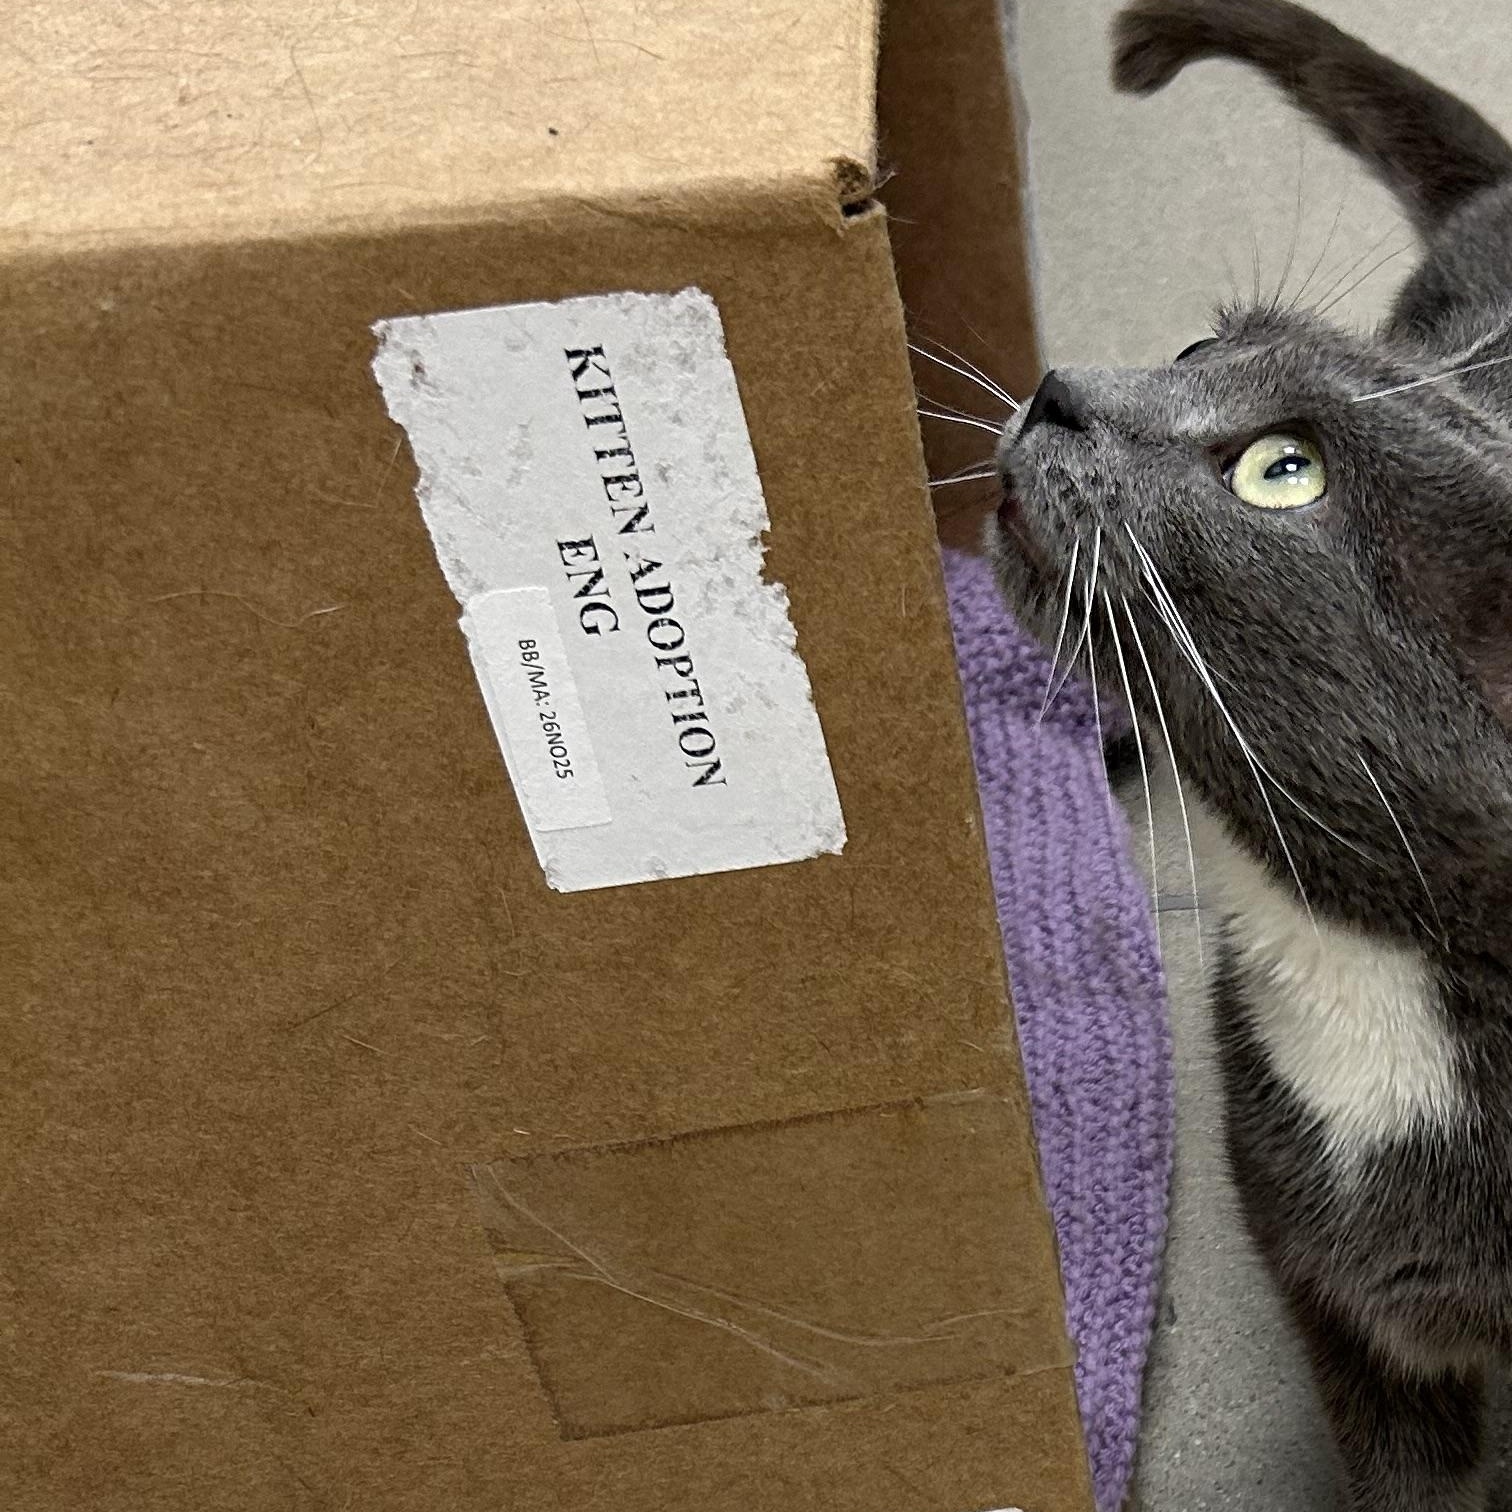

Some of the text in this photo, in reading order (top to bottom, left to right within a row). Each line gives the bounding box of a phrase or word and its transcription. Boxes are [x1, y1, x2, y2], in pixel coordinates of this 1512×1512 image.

[555, 534, 621, 637] ENG
[563, 344, 727, 787] KITTEN ADOPTION
[518, 639, 574, 779] BB/MA: 26NO25
